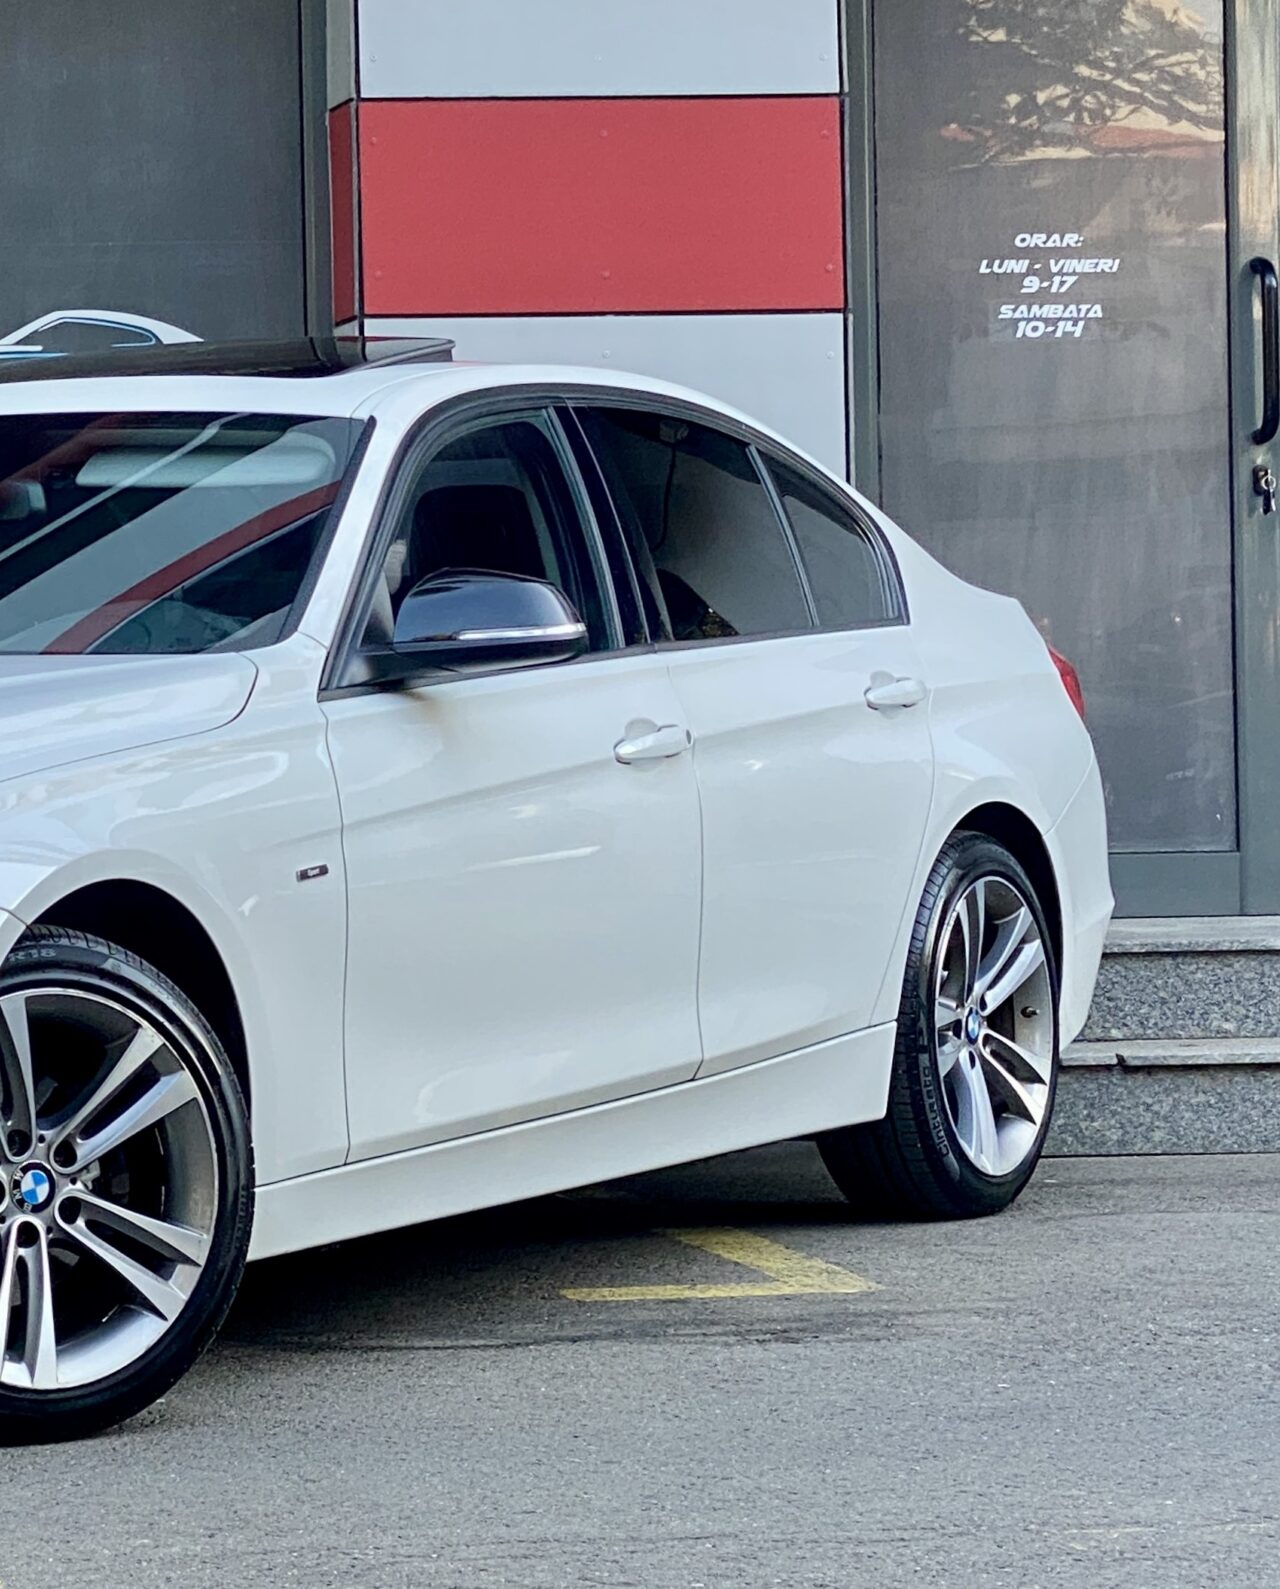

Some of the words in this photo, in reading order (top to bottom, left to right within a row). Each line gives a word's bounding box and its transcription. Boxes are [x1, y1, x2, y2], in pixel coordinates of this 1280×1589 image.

[1014, 232, 1084, 248] ORAR:
[979, 258, 1030, 274] LUNI
[1049, 257, 1120, 273] VINERI
[1020, 275, 1078, 293] 9-17
[998, 304, 1103, 319] SAMBATA
[1015, 320, 1086, 338] 10-14
